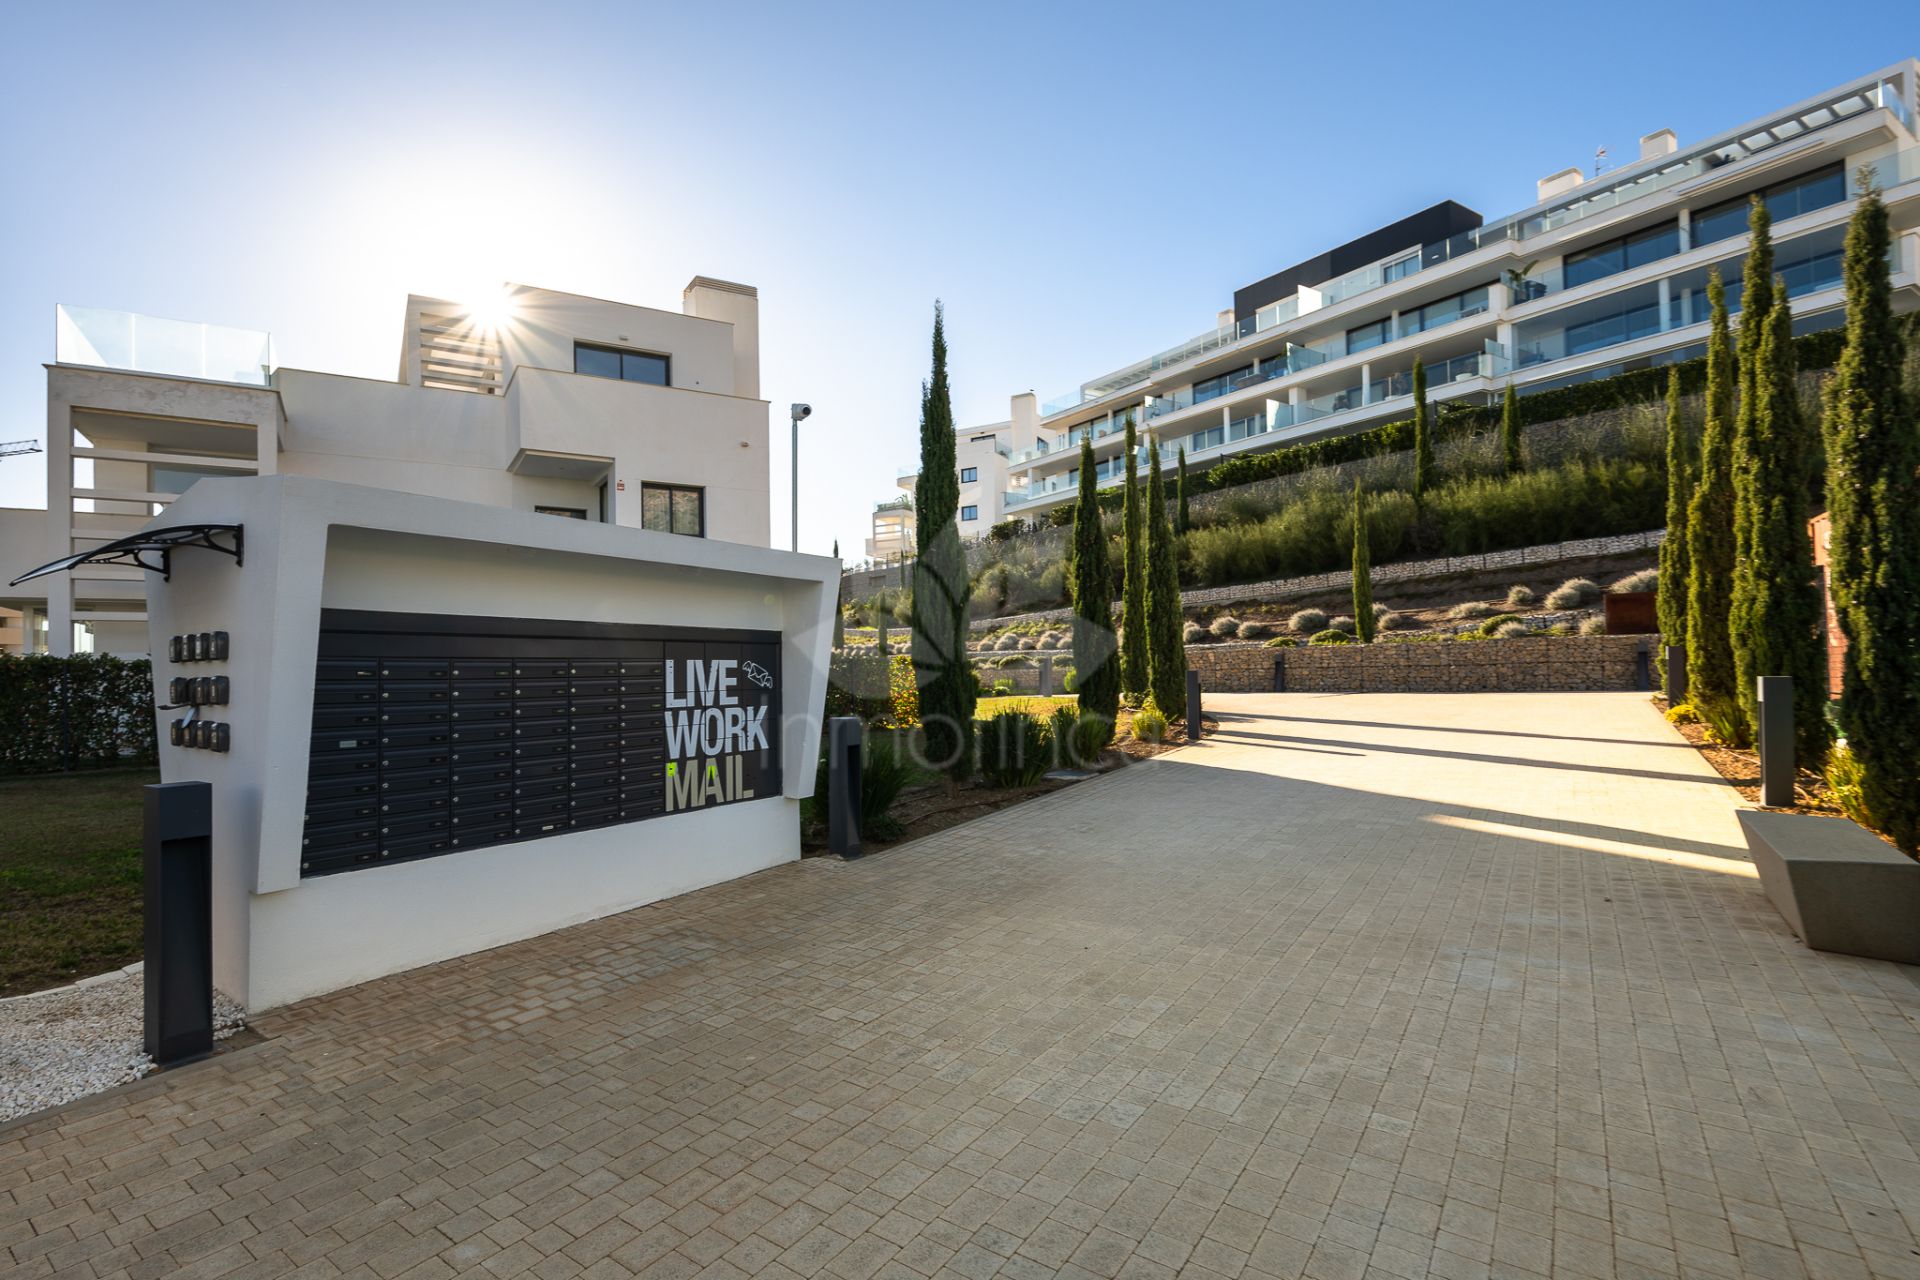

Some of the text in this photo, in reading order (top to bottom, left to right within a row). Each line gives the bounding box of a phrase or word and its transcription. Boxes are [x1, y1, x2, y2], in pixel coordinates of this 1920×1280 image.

[665, 659, 739, 709] LIVE
[664, 705, 769, 760] WORK
[665, 754, 755, 812] MAIL
